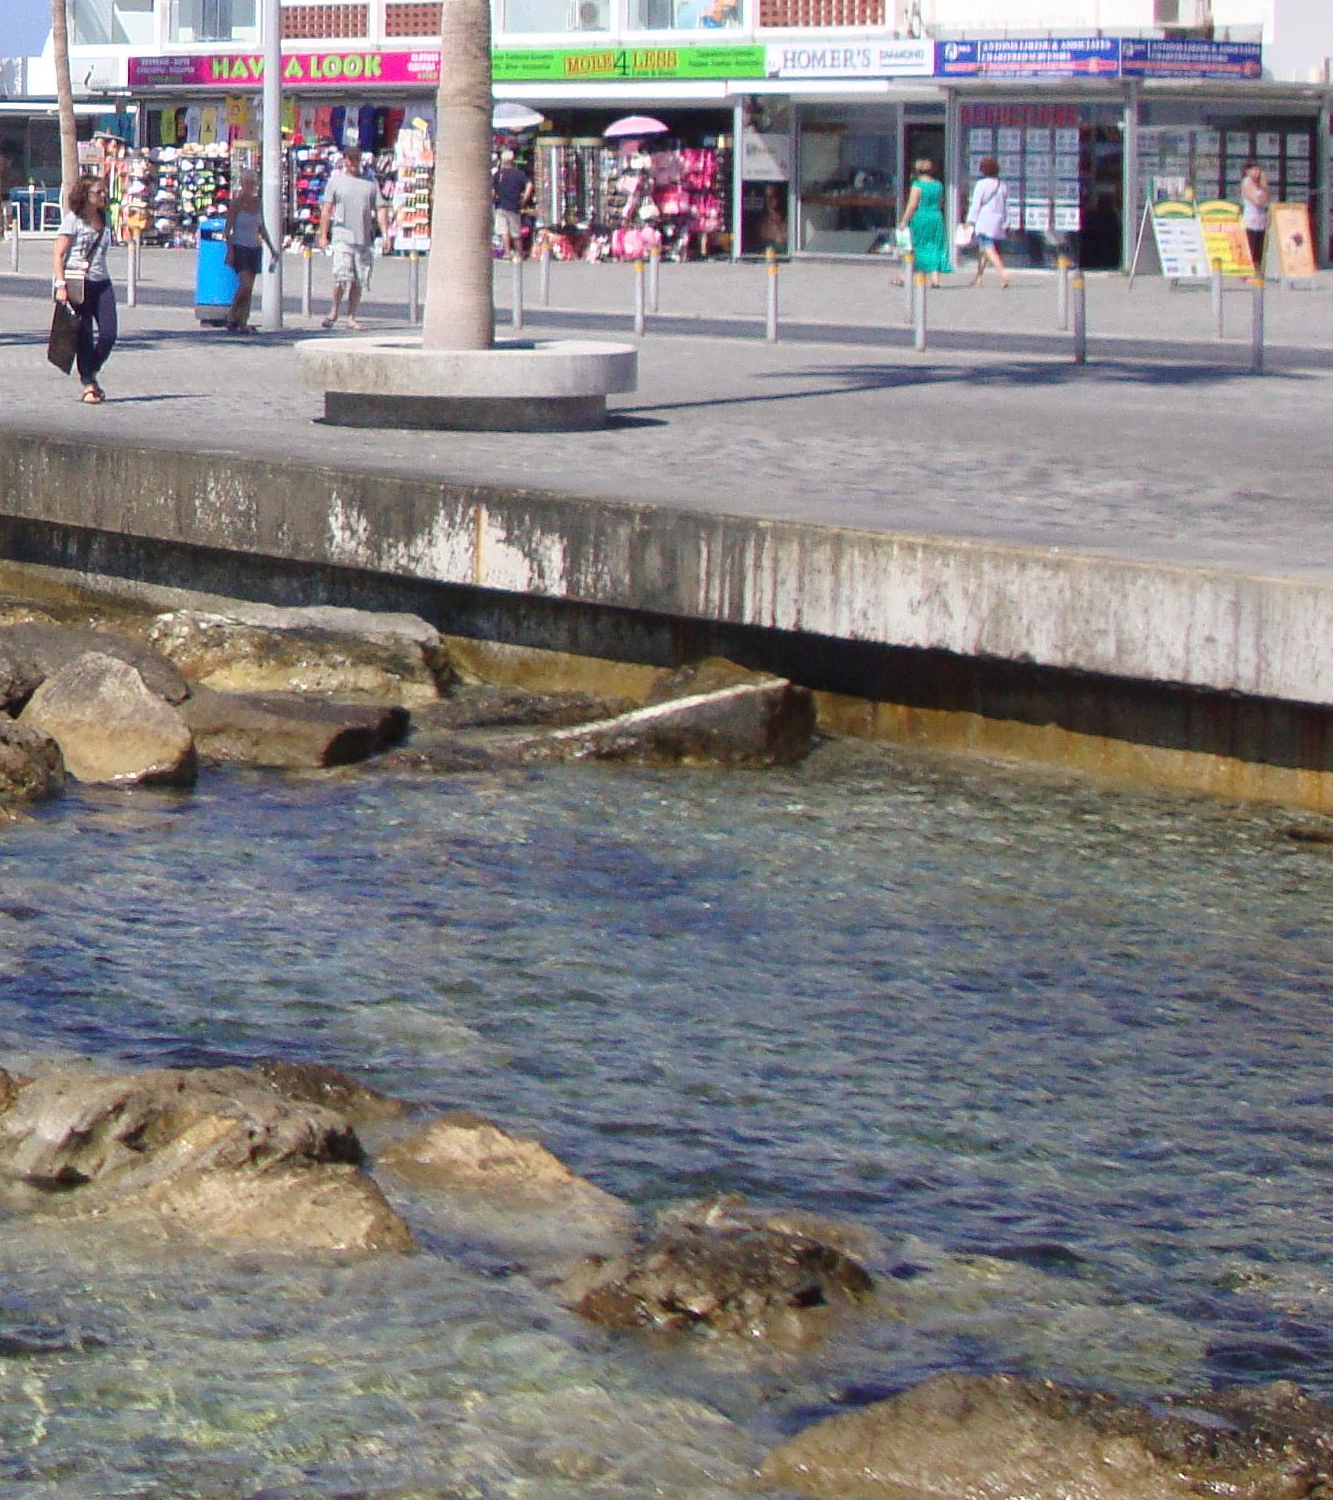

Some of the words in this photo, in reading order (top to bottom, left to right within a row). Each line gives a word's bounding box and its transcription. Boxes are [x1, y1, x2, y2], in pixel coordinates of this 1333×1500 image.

[212, 56, 265, 79] HAV
[284, 56, 304, 79] A
[310, 54, 382, 79] LOOK
[614, 50, 630, 76] 4
[783, 48, 872, 69] HOMER'S
